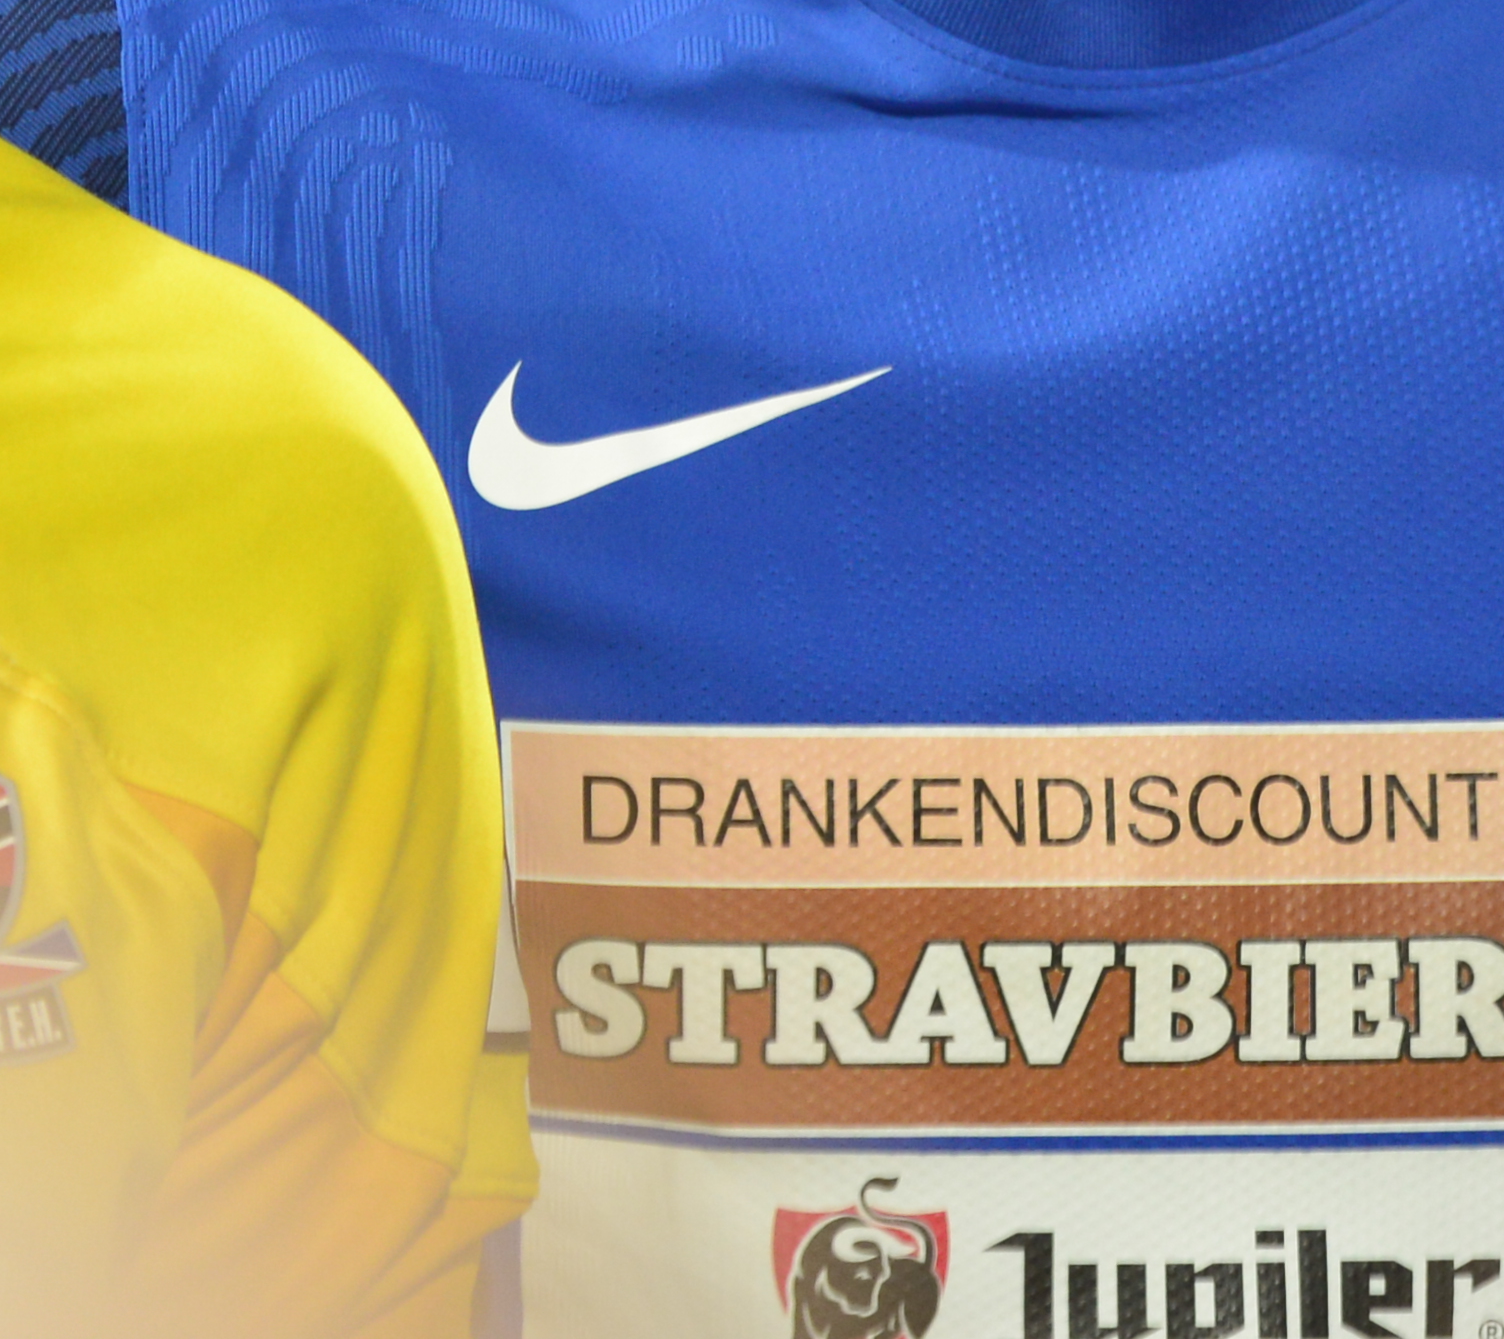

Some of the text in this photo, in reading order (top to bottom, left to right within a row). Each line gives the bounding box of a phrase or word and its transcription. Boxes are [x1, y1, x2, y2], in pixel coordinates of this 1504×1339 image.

[581, 772, 1498, 847] DRANKENDISCOUNT
[8, 998, 63, 1049] E.H.
[984, 1229, 1501, 1339] Jupiler
